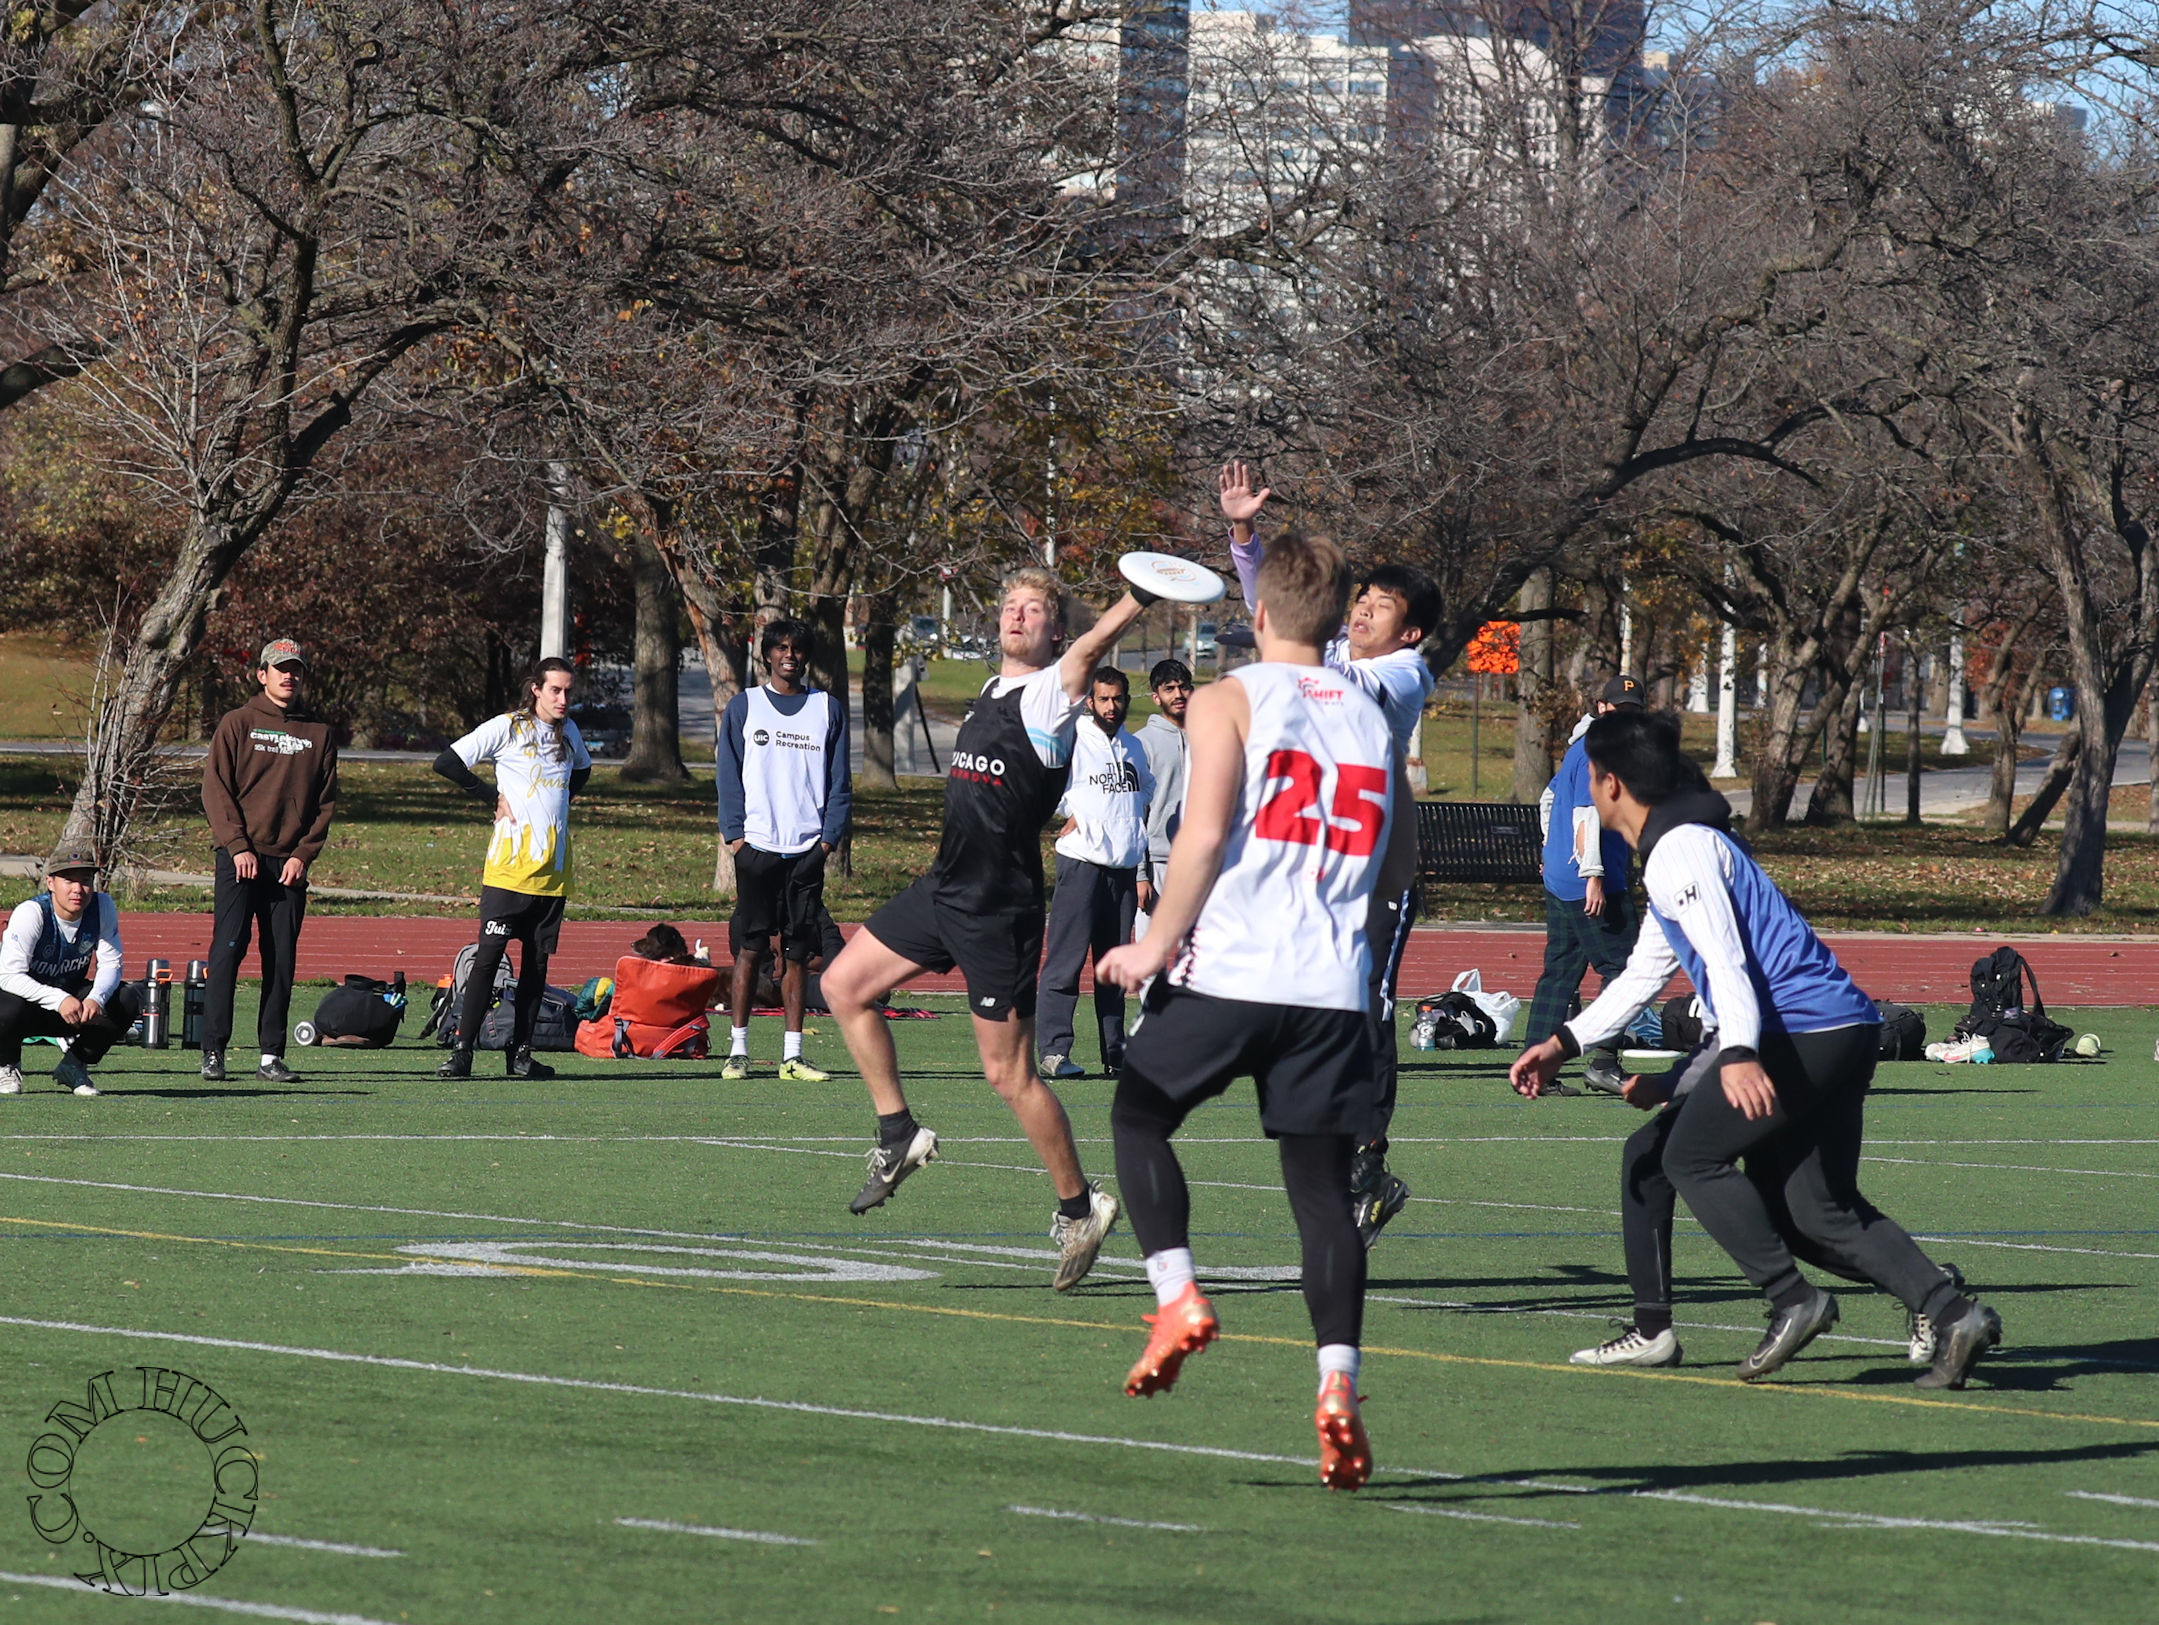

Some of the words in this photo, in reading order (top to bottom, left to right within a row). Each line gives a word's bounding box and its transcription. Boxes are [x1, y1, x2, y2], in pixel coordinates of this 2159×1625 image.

[1624, 680, 1635, 691] P
[754, 734, 769, 742] UIC
[775, 731, 810, 741] Campus
[775, 739, 821, 752] Recreation
[1089, 773, 1125, 785] NOR
[1103, 783, 1127, 794] FACE
[1255, 750, 1387, 856] 25
